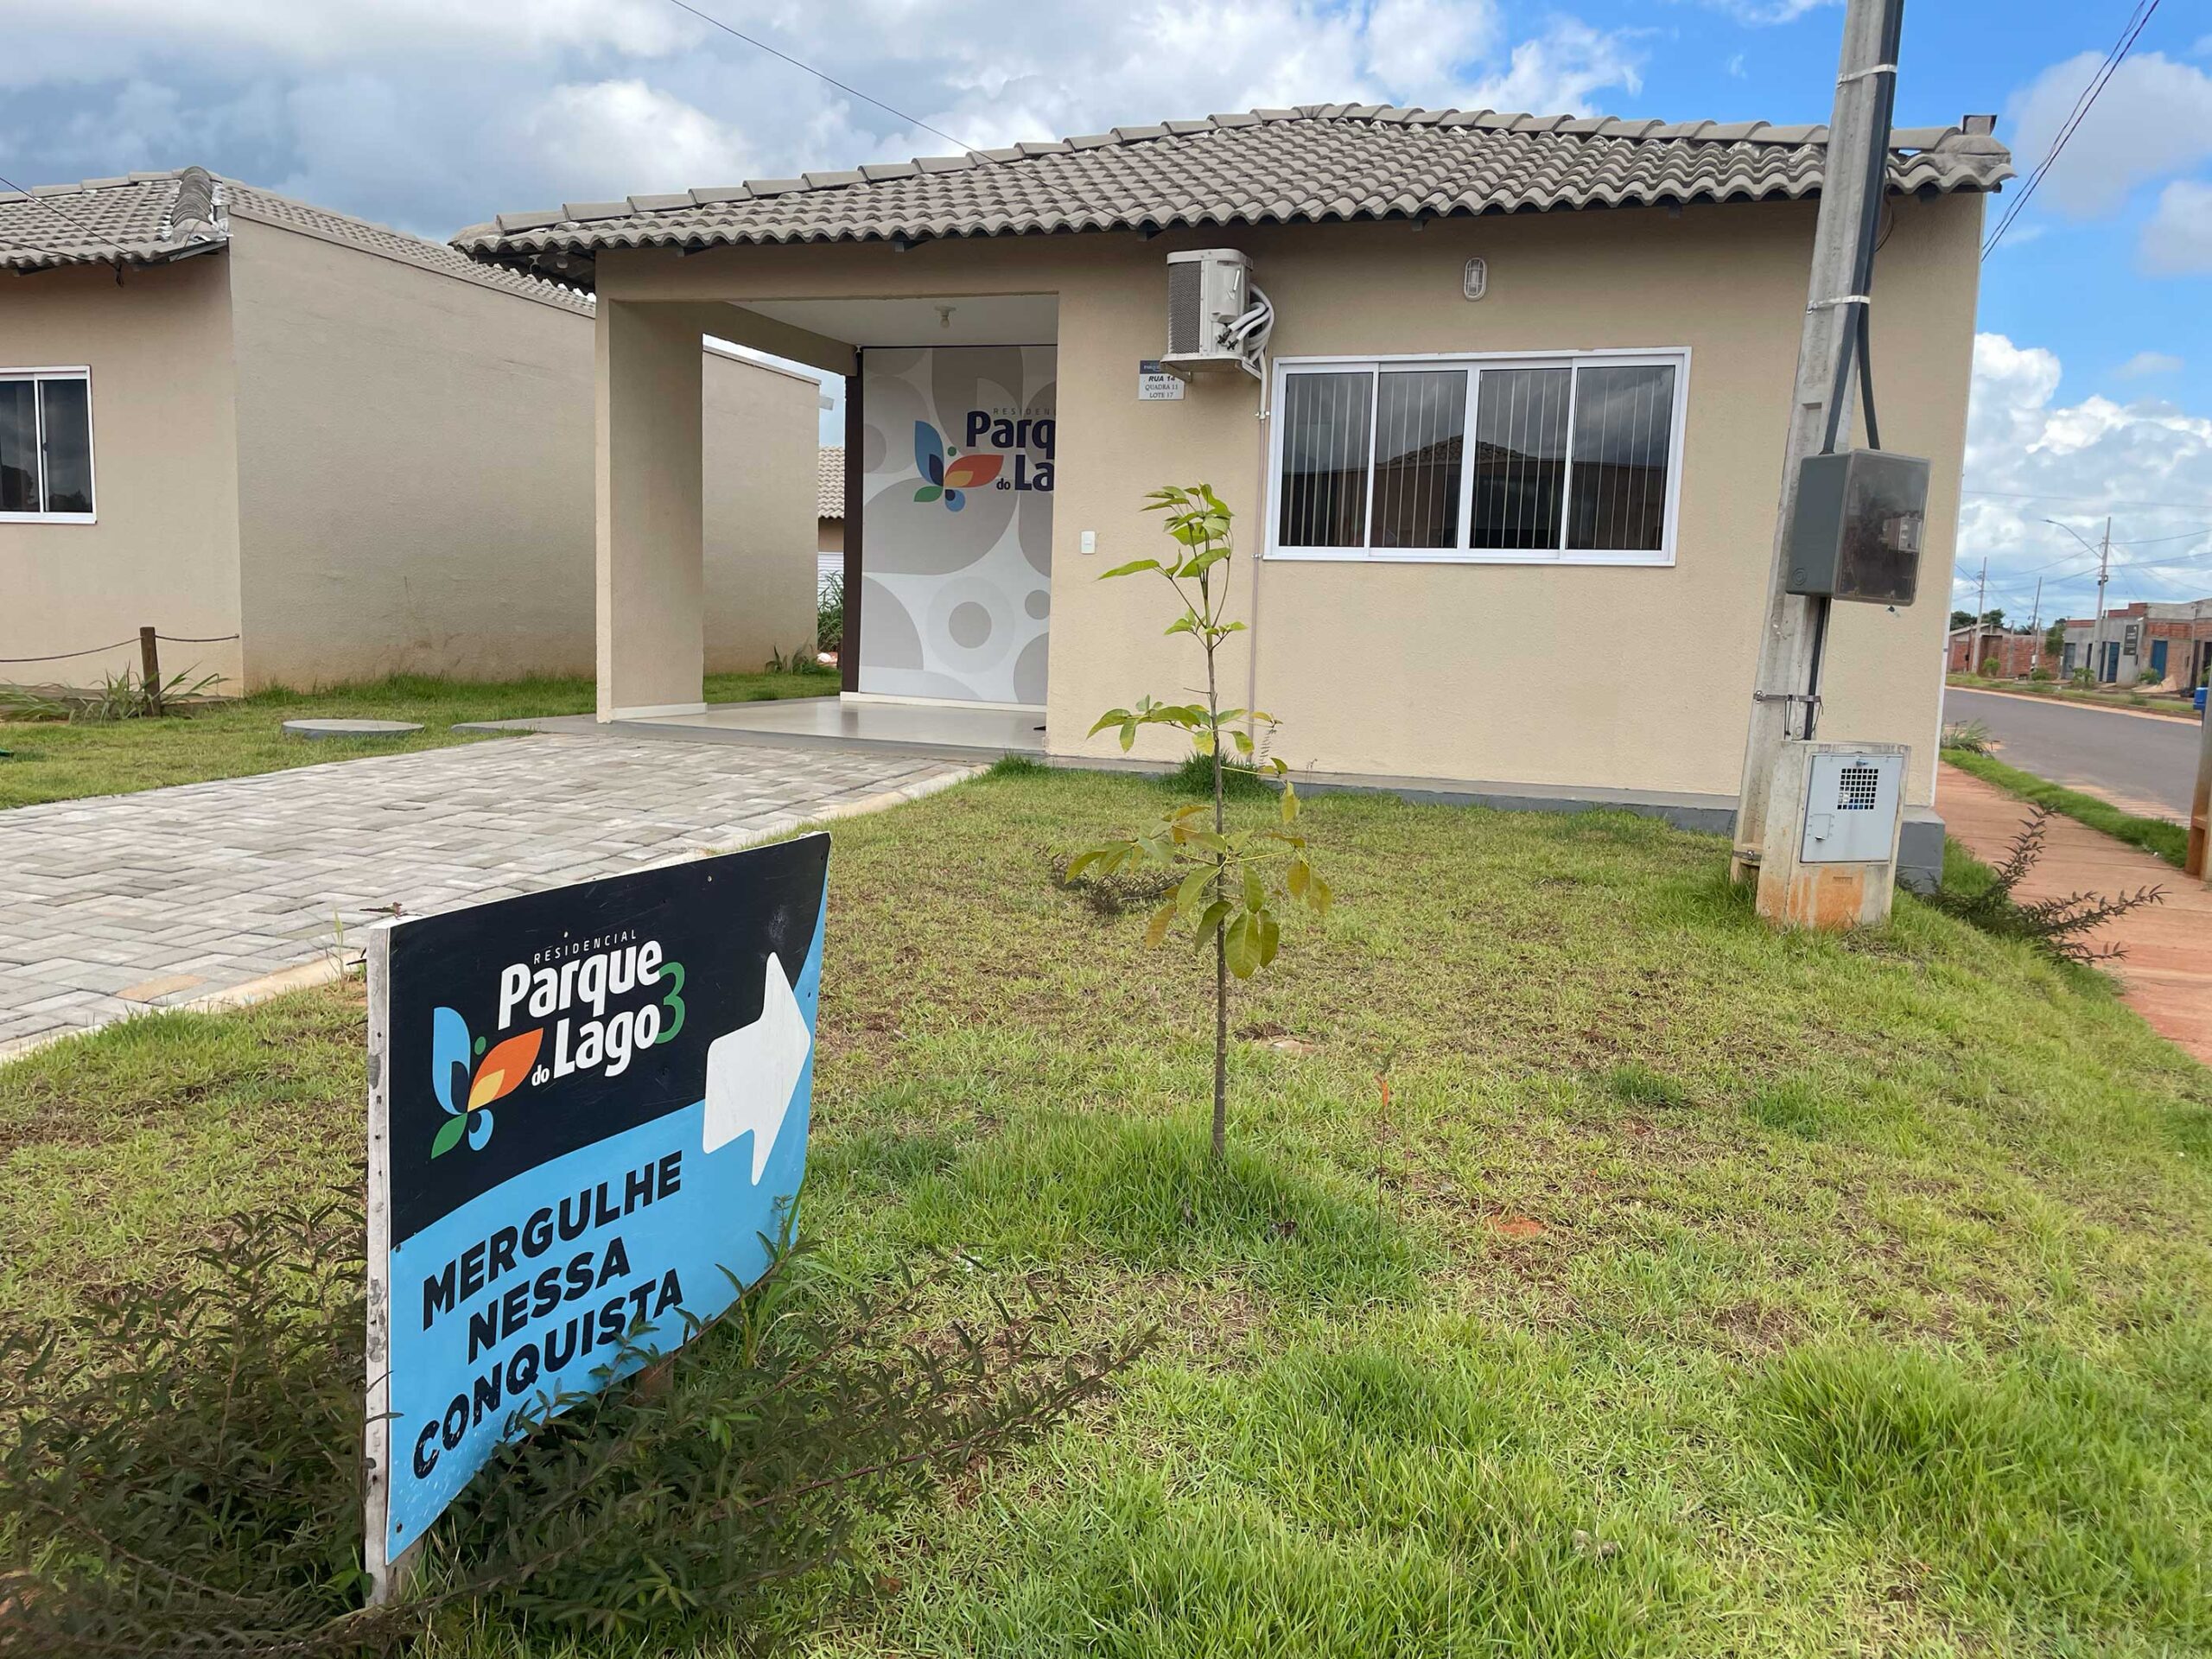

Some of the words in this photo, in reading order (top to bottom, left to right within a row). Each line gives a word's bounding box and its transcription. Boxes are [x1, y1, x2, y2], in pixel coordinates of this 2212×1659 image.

[996, 478, 1011, 491] do
[1014, 454, 1055, 492] La
[498, 940, 663, 1031] Parque
[533, 929, 637, 965] RESIDENCIAL
[531, 1064, 550, 1087] do
[553, 1003, 661, 1077] Lago
[653, 961, 685, 1045] 3
[422, 1150, 683, 1332] MERGULHE
[467, 1236, 631, 1364] NESSA
[412, 1268, 683, 1479] CONQUISTA
